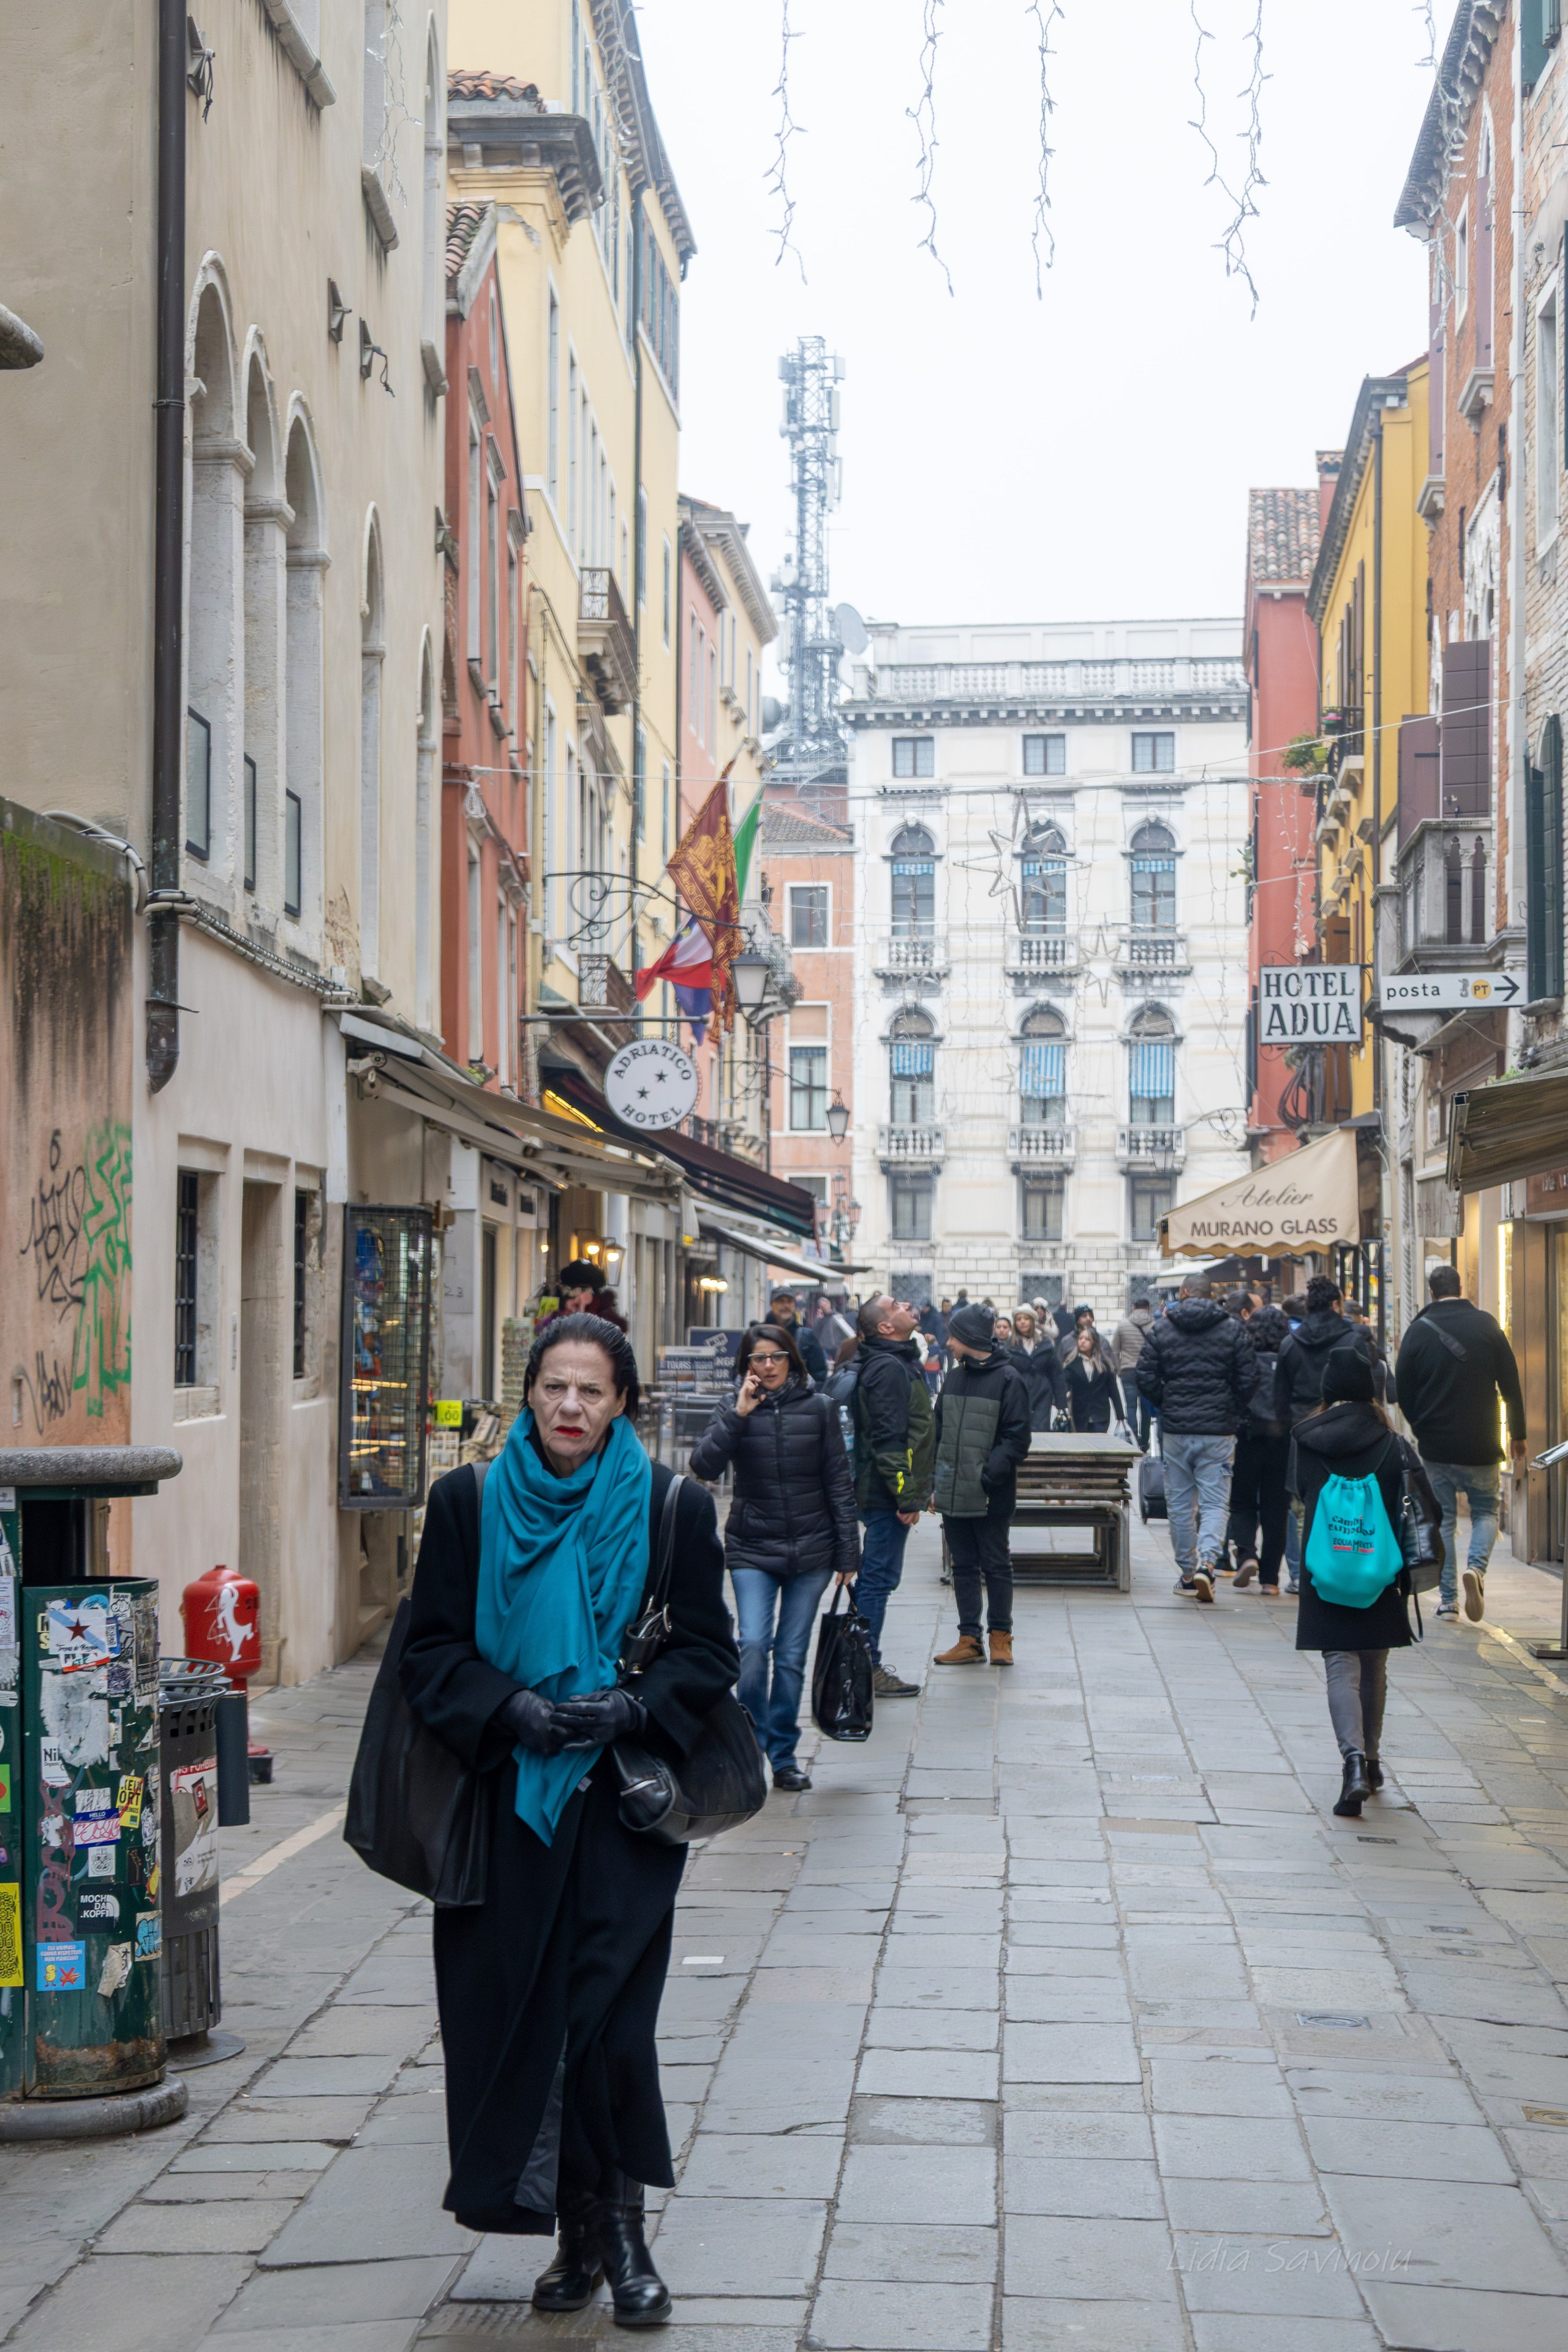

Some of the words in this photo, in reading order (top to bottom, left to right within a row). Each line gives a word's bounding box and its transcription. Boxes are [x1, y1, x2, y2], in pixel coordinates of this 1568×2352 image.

[1264, 972, 1355, 997] HOTEL
[1386, 982, 1441, 1000] posta
[1474, 984, 1488, 995] PT
[1265, 1002, 1357, 1036] ADUA
[614, 1044, 692, 1080] ADRIATICO
[622, 1104, 682, 1125] HOTEL
[1220, 1182, 1314, 1208] Atelier
[1190, 1219, 1273, 1237] MURANO
[1281, 1217, 1338, 1234] GLASS
[119, 1790, 141, 1806] ORT
[80, 1894, 107, 1903] MOCH
